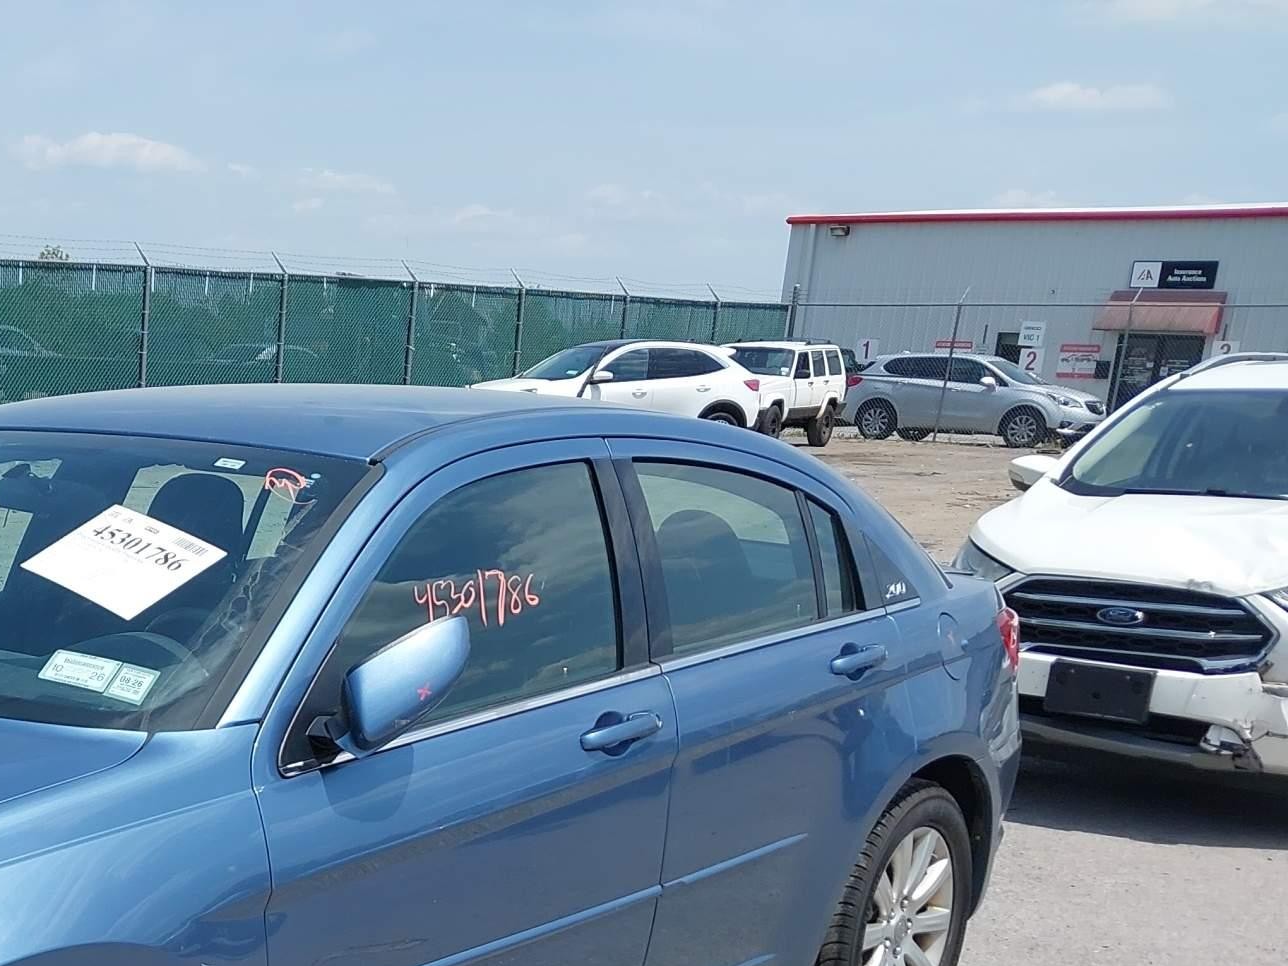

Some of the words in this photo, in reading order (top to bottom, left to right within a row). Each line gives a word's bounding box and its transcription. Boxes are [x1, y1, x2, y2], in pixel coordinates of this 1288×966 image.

[862, 340, 870, 359] 1
[1024, 351, 1037, 371] 2
[92, 524, 189, 573] 45301786
[413, 569, 540, 628] 45301786
[52, 663, 64, 673] 10
[88, 671, 106, 682] 26
